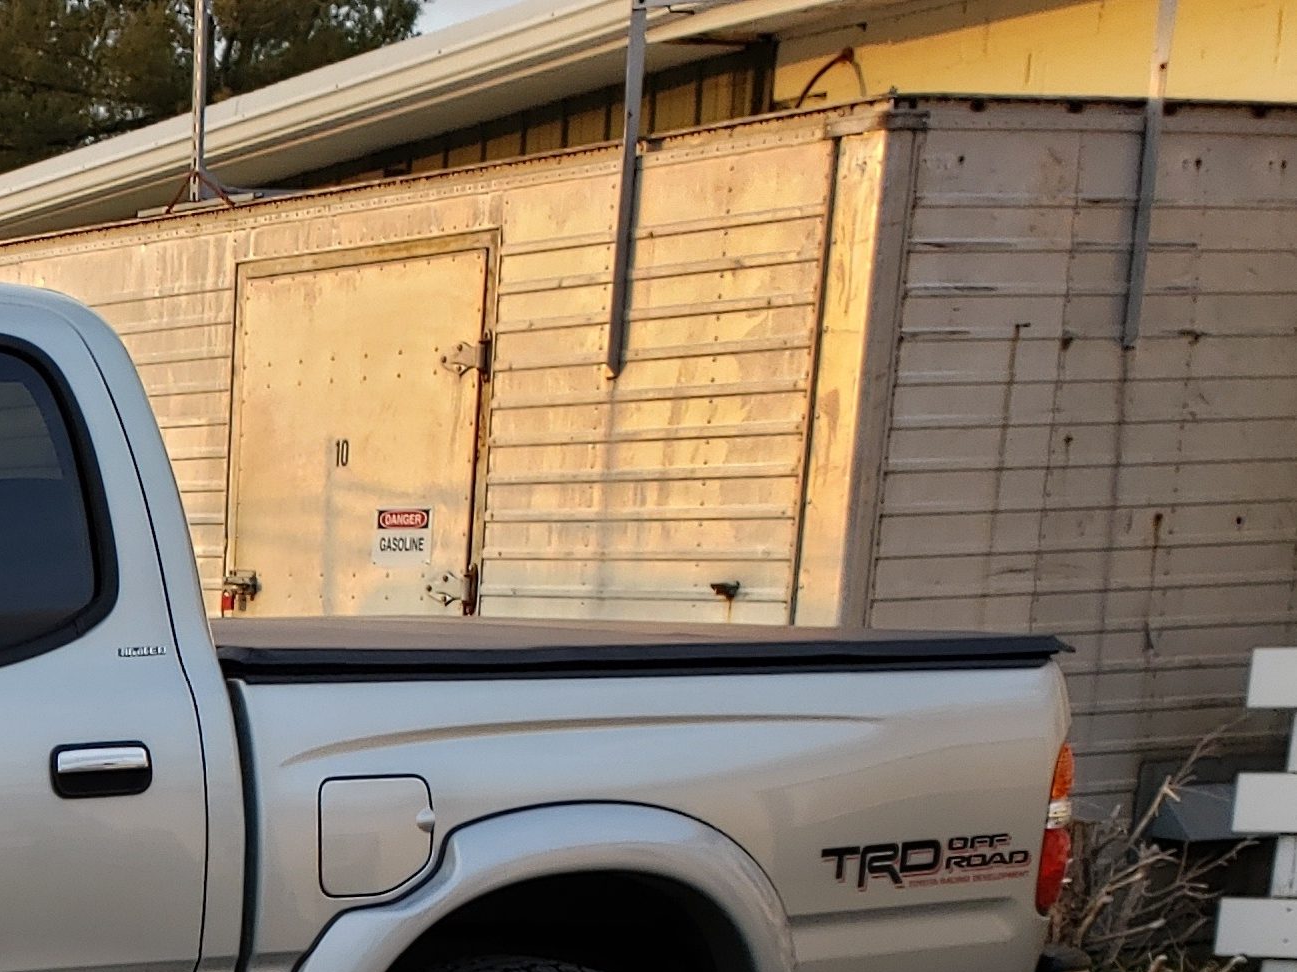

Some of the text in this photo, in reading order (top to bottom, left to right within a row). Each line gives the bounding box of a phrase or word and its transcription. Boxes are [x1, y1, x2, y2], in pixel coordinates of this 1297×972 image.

[336, 440, 349, 468] 10
[384, 513, 422, 526] DANGER
[379, 537, 425, 552] GASOLINE
[948, 833, 1011, 851] OFF
[821, 839, 943, 890] TRD
[945, 850, 1030, 871] ROAD
